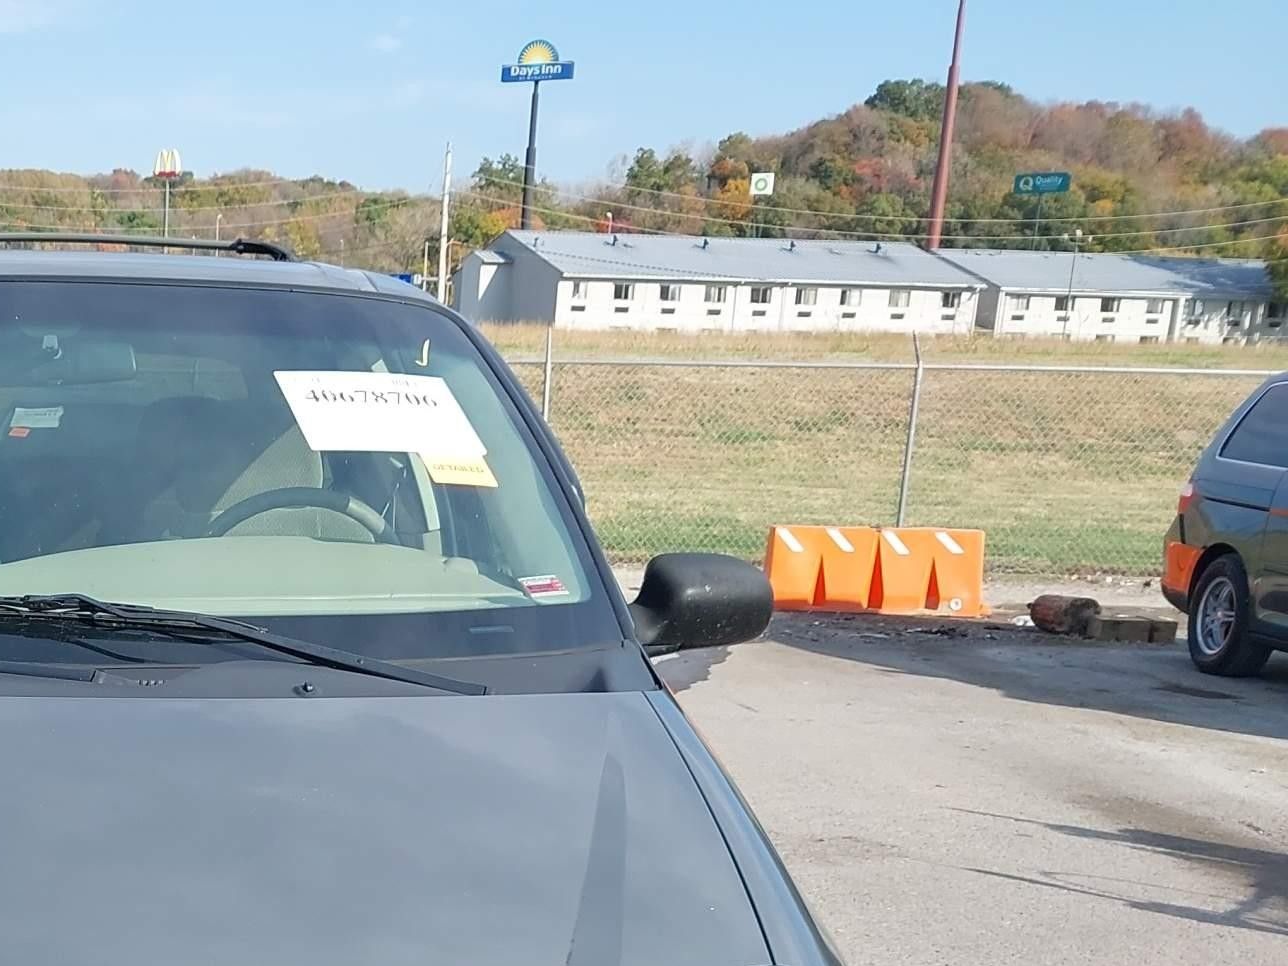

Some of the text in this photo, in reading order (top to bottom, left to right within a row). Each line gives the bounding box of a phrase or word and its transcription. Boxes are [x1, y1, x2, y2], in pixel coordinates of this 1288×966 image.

[510, 64, 563, 77] Days Inn
[1035, 175, 1064, 185] Quality
